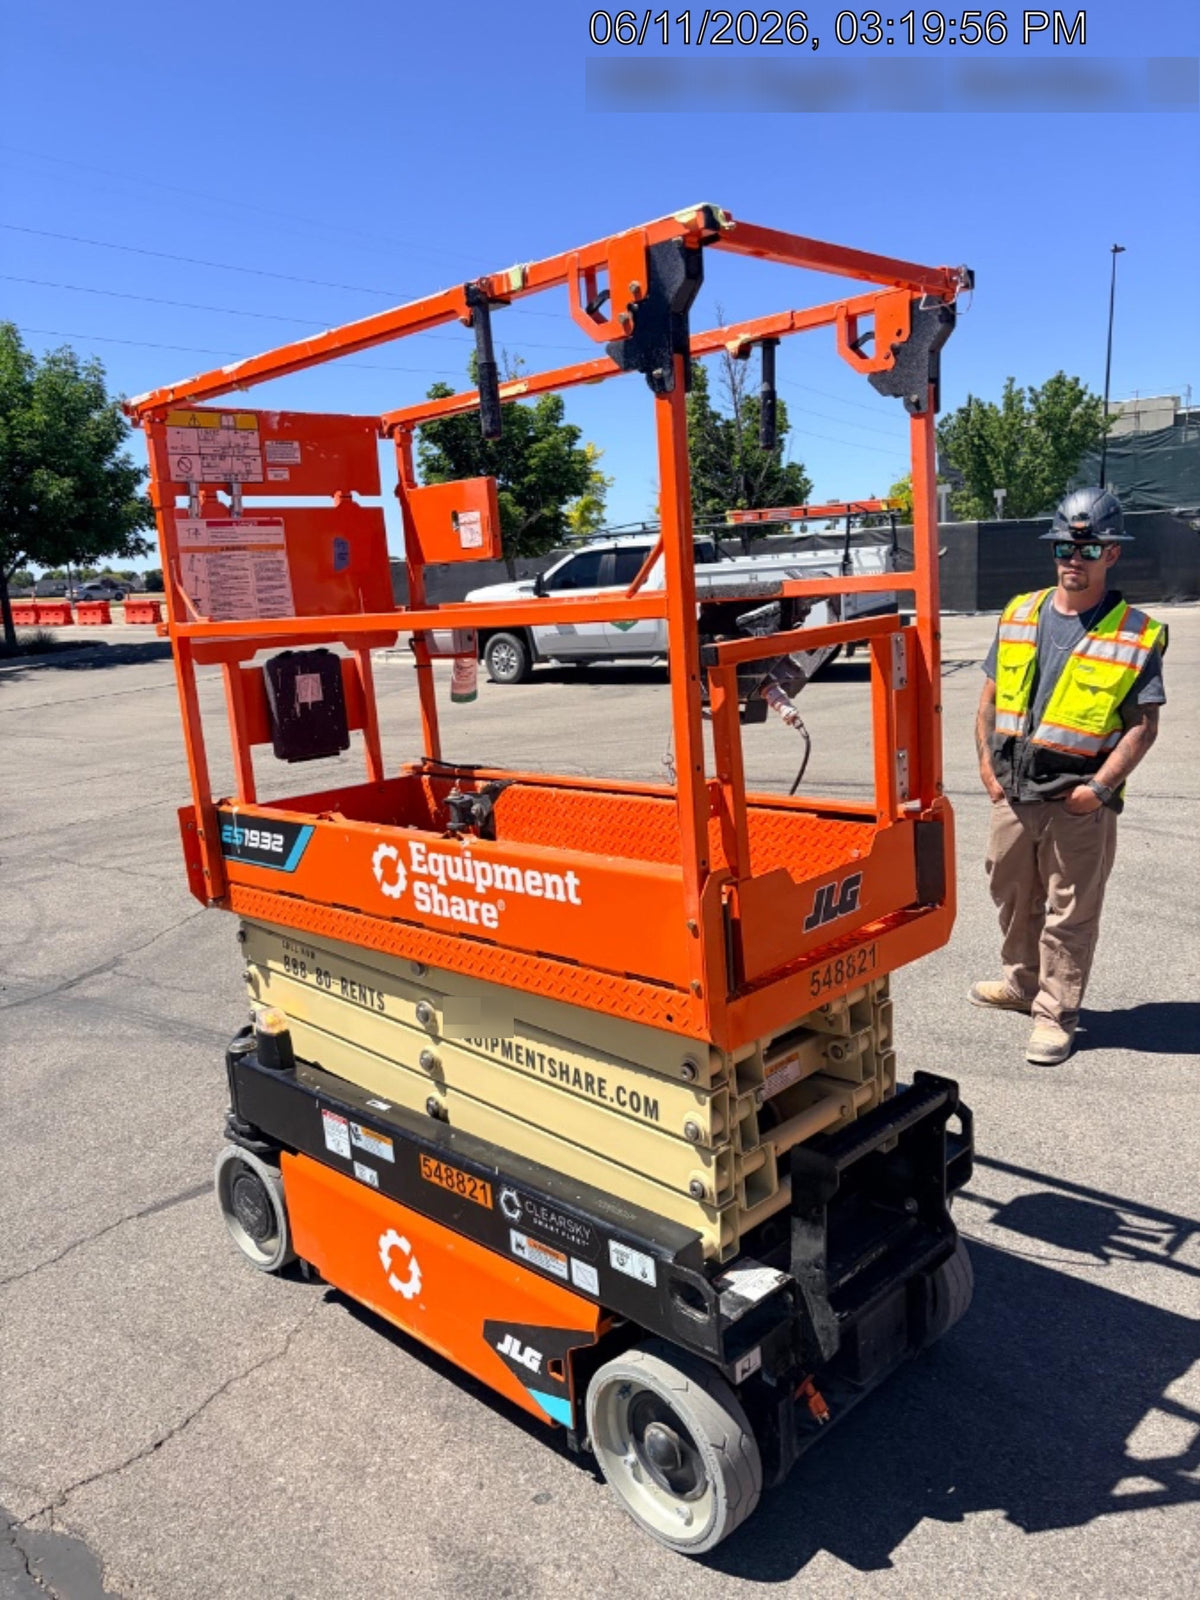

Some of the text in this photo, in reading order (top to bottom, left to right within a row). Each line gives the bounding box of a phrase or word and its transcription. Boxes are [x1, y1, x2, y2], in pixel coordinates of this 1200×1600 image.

[408, 841, 582, 906] Equipment
[802, 870, 863, 934] JLG
[810, 942, 877, 997] 548821
[463, 1037, 660, 1122] UIPMENTSHARE.COM
[421, 1155, 491, 1206] 548821
[524, 1200, 592, 1240] CLEARSKY
[496, 1333, 543, 1375] JLG
